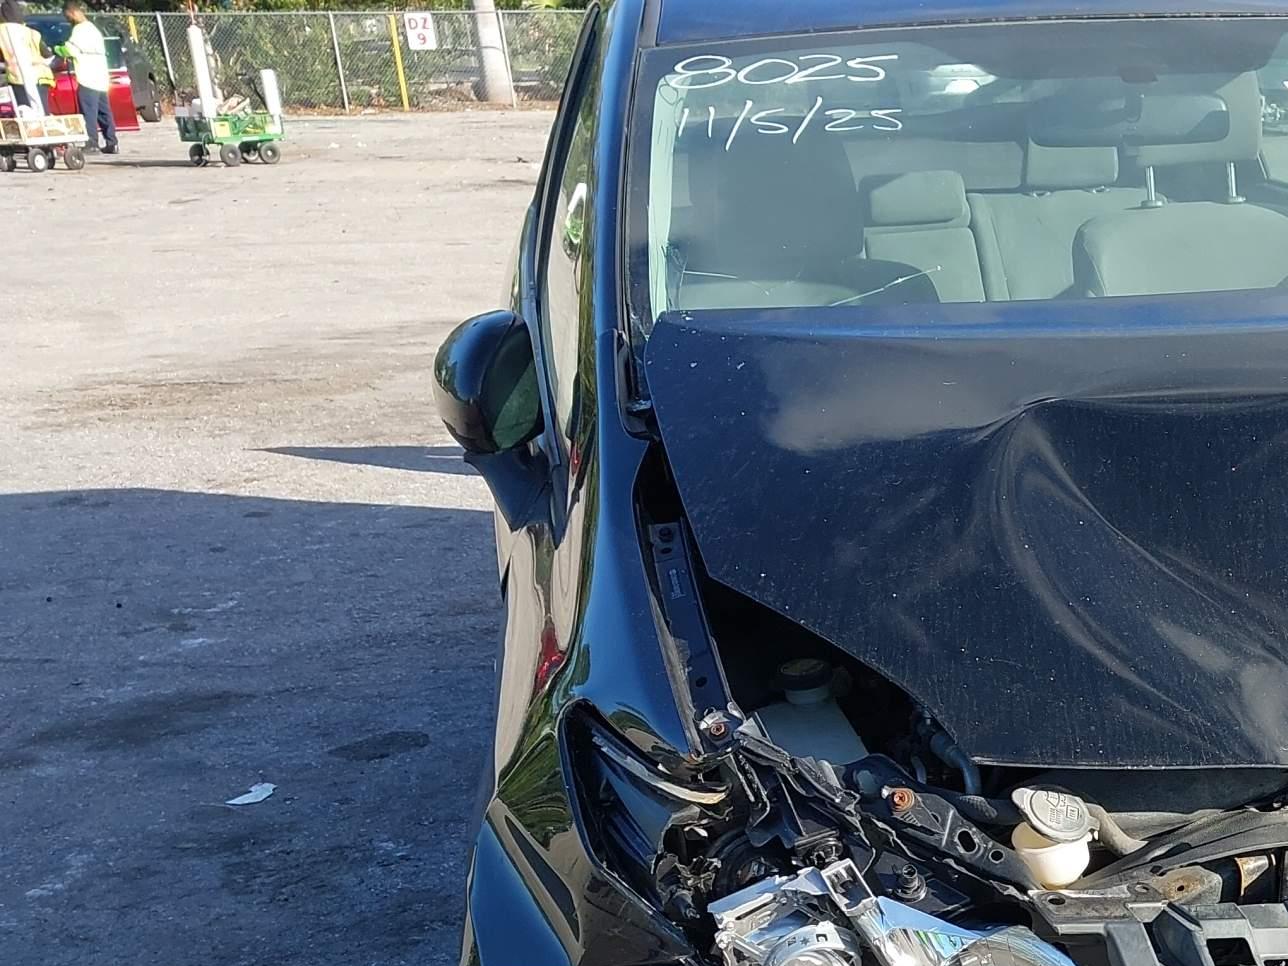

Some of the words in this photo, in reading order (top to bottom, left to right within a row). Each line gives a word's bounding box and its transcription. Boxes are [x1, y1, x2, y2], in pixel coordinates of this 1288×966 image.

[417, 33, 427, 45] 9
[668, 54, 899, 89] 8025
[677, 96, 903, 151] 11/5/25
